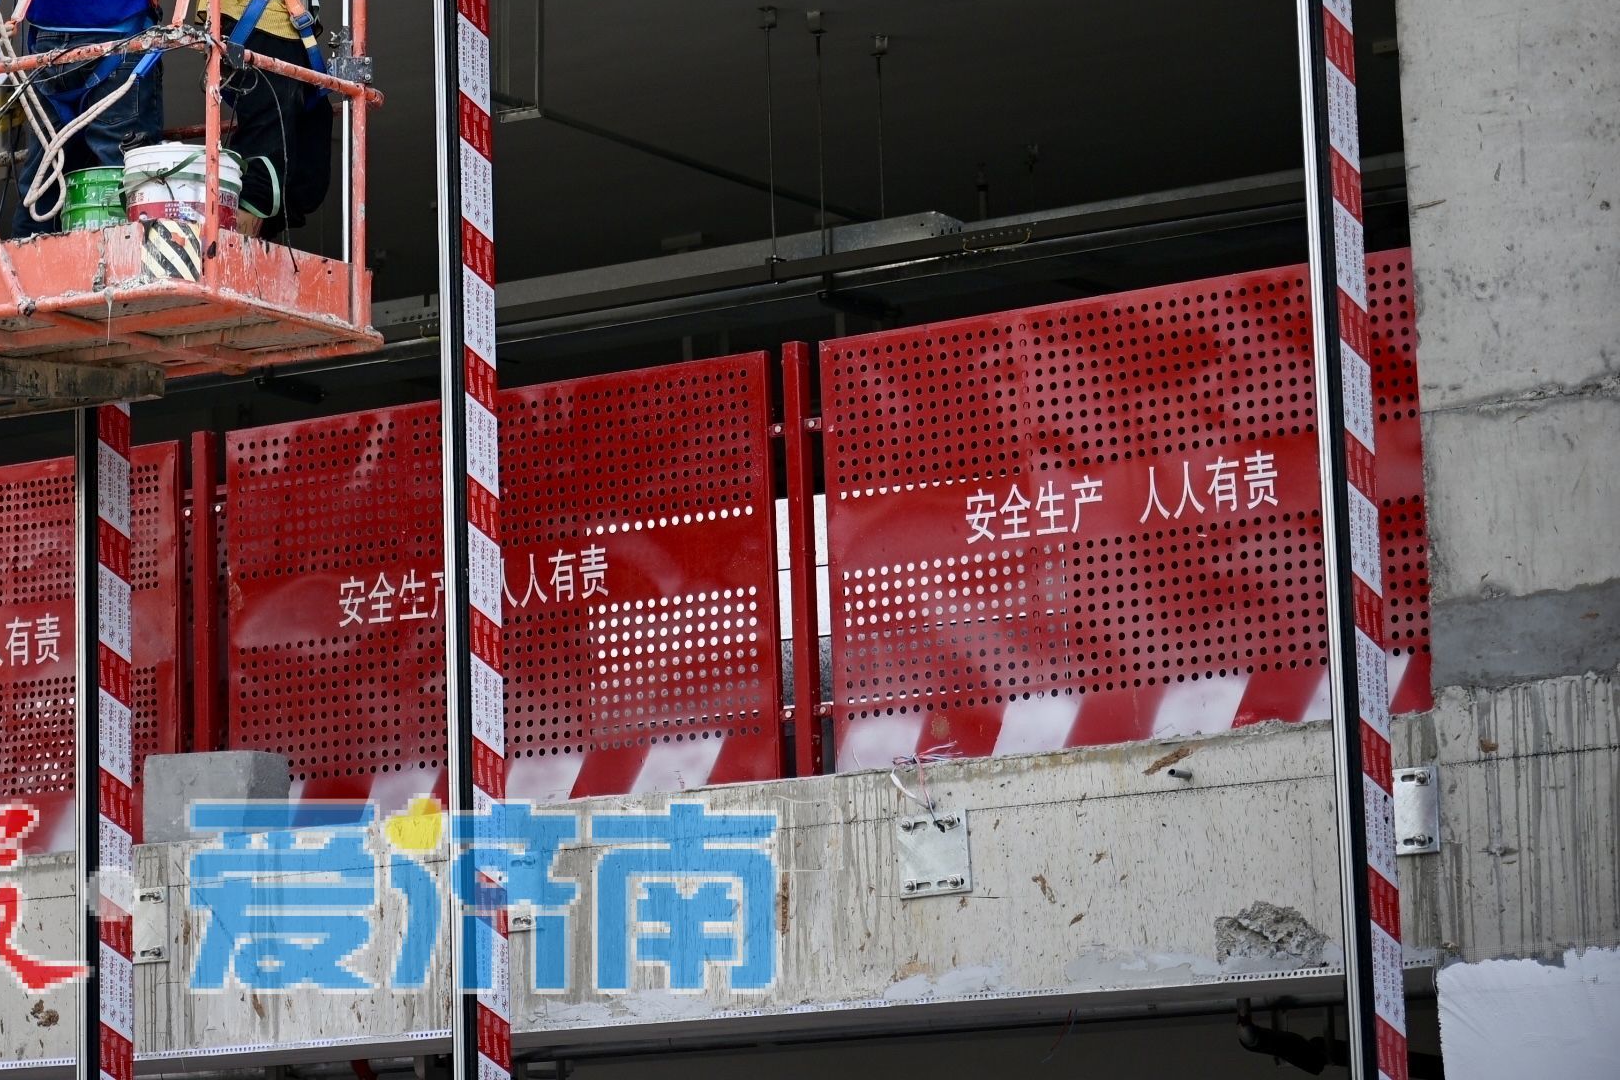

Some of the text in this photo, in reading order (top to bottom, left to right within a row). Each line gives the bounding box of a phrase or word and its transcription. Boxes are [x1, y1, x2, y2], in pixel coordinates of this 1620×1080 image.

[966, 449, 1279, 544] 安全生产 人人有责
